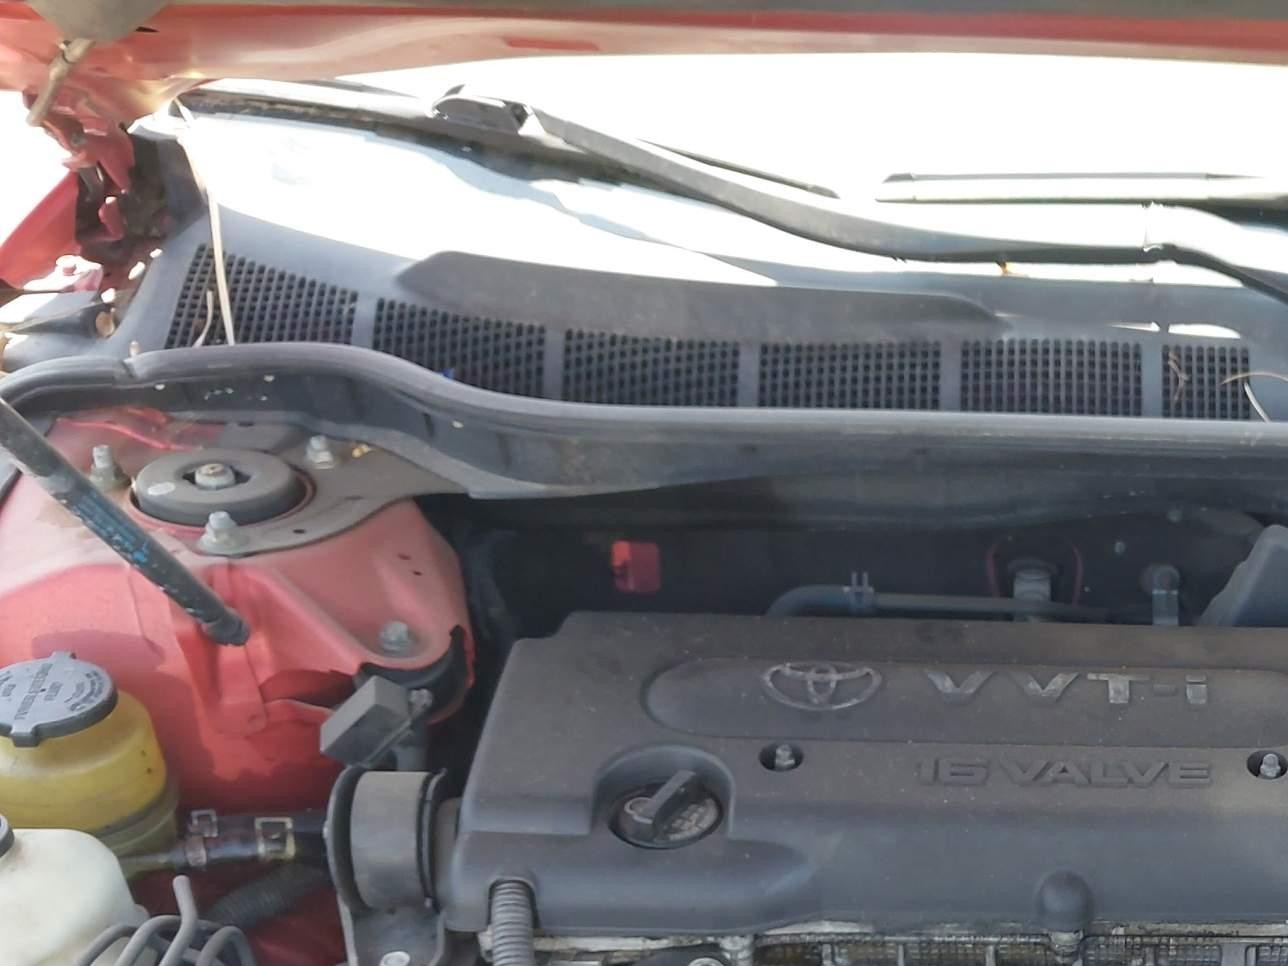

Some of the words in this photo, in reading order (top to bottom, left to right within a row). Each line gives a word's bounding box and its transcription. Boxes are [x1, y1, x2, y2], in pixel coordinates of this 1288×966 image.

[924, 670, 1208, 705] VVT-i
[918, 760, 988, 788] 16
[1003, 760, 1213, 788] VALVE
